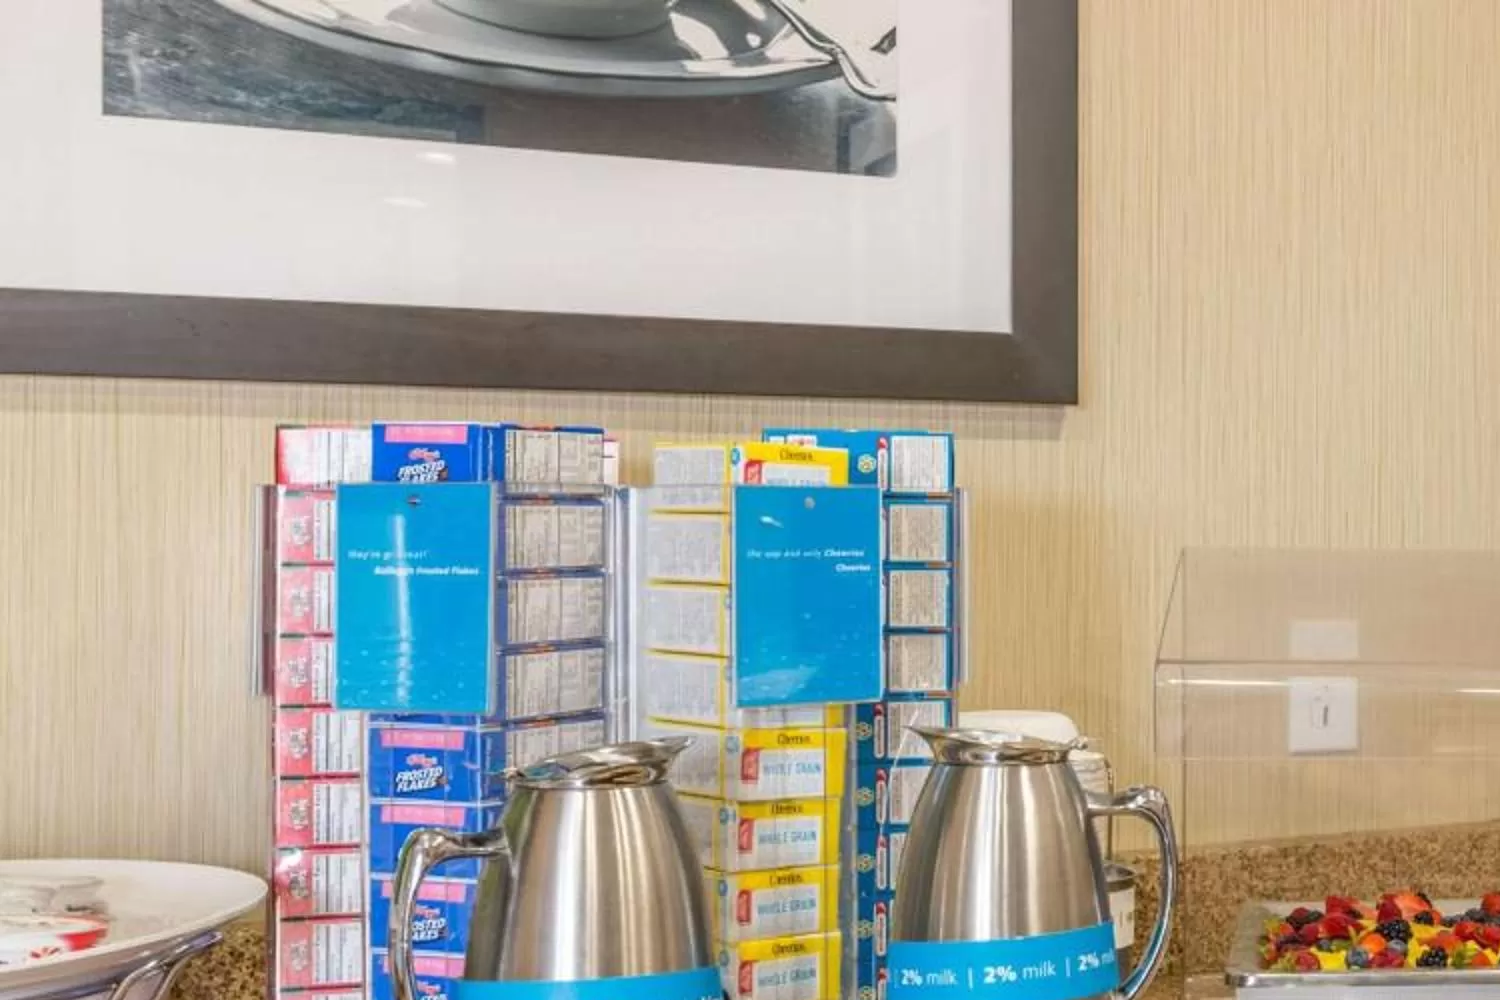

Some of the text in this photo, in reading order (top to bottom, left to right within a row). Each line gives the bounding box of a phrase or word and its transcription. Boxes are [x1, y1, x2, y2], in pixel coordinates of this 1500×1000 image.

[396, 765, 443, 783] FROSTED
[397, 776, 438, 793] FLAKES
[901, 968, 922, 985] 2%
[927, 969, 957, 985] milk
[984, 965, 1017, 984] 2%
[1023, 960, 1056, 979] milk
[1077, 952, 1099, 971] 2%
